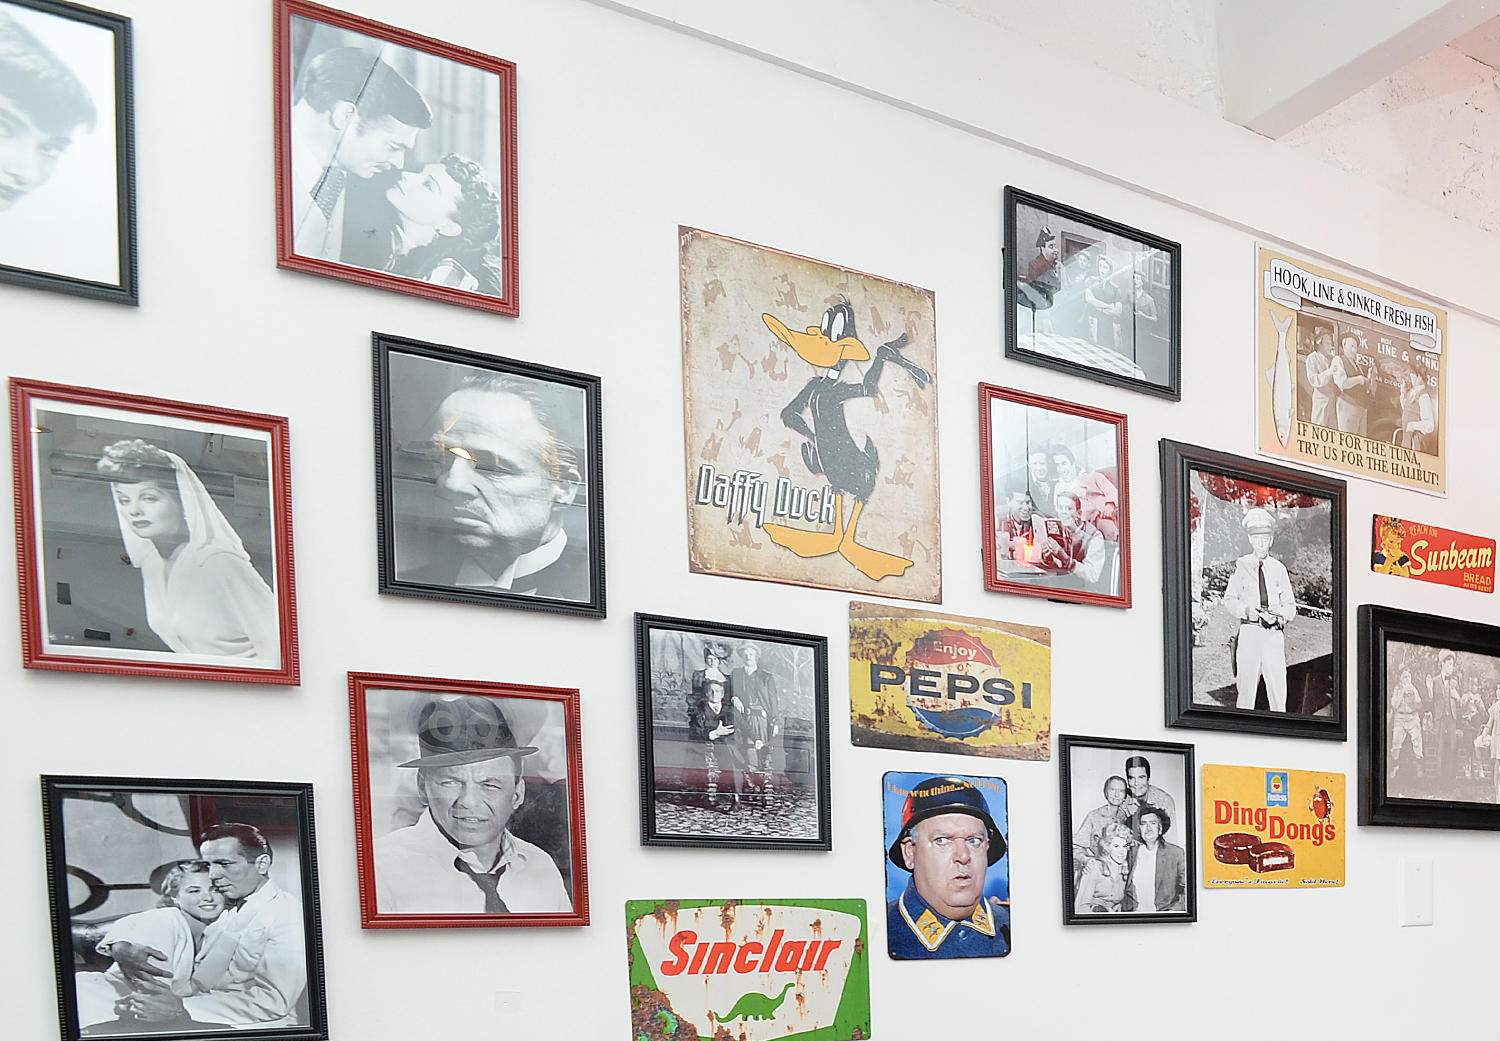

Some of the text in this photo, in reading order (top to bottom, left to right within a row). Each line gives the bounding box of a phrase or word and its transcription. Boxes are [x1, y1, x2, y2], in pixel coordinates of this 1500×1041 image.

[1274, 266, 1434, 333] HOOK, LINE & SINKER FRESH FISH
[1377, 343, 1397, 358] LINE
[1401, 351, 1409, 363] &
[1297, 422, 1421, 467] IF NOT FOR THE TUNA,
[1297, 439, 1440, 486] TRY US FOR THE HALIBUT!
[696, 463, 837, 529] Daffy Duck
[1409, 539, 1492, 576] Sunbeam
[1463, 572, 1492, 586] BREAD
[933, 640, 977, 660] Enjoy
[870, 663, 1032, 709] PEPSI
[1214, 800, 1268, 832] Ding
[1269, 816, 1336, 847] Dongs
[660, 929, 842, 976] Sinclair
